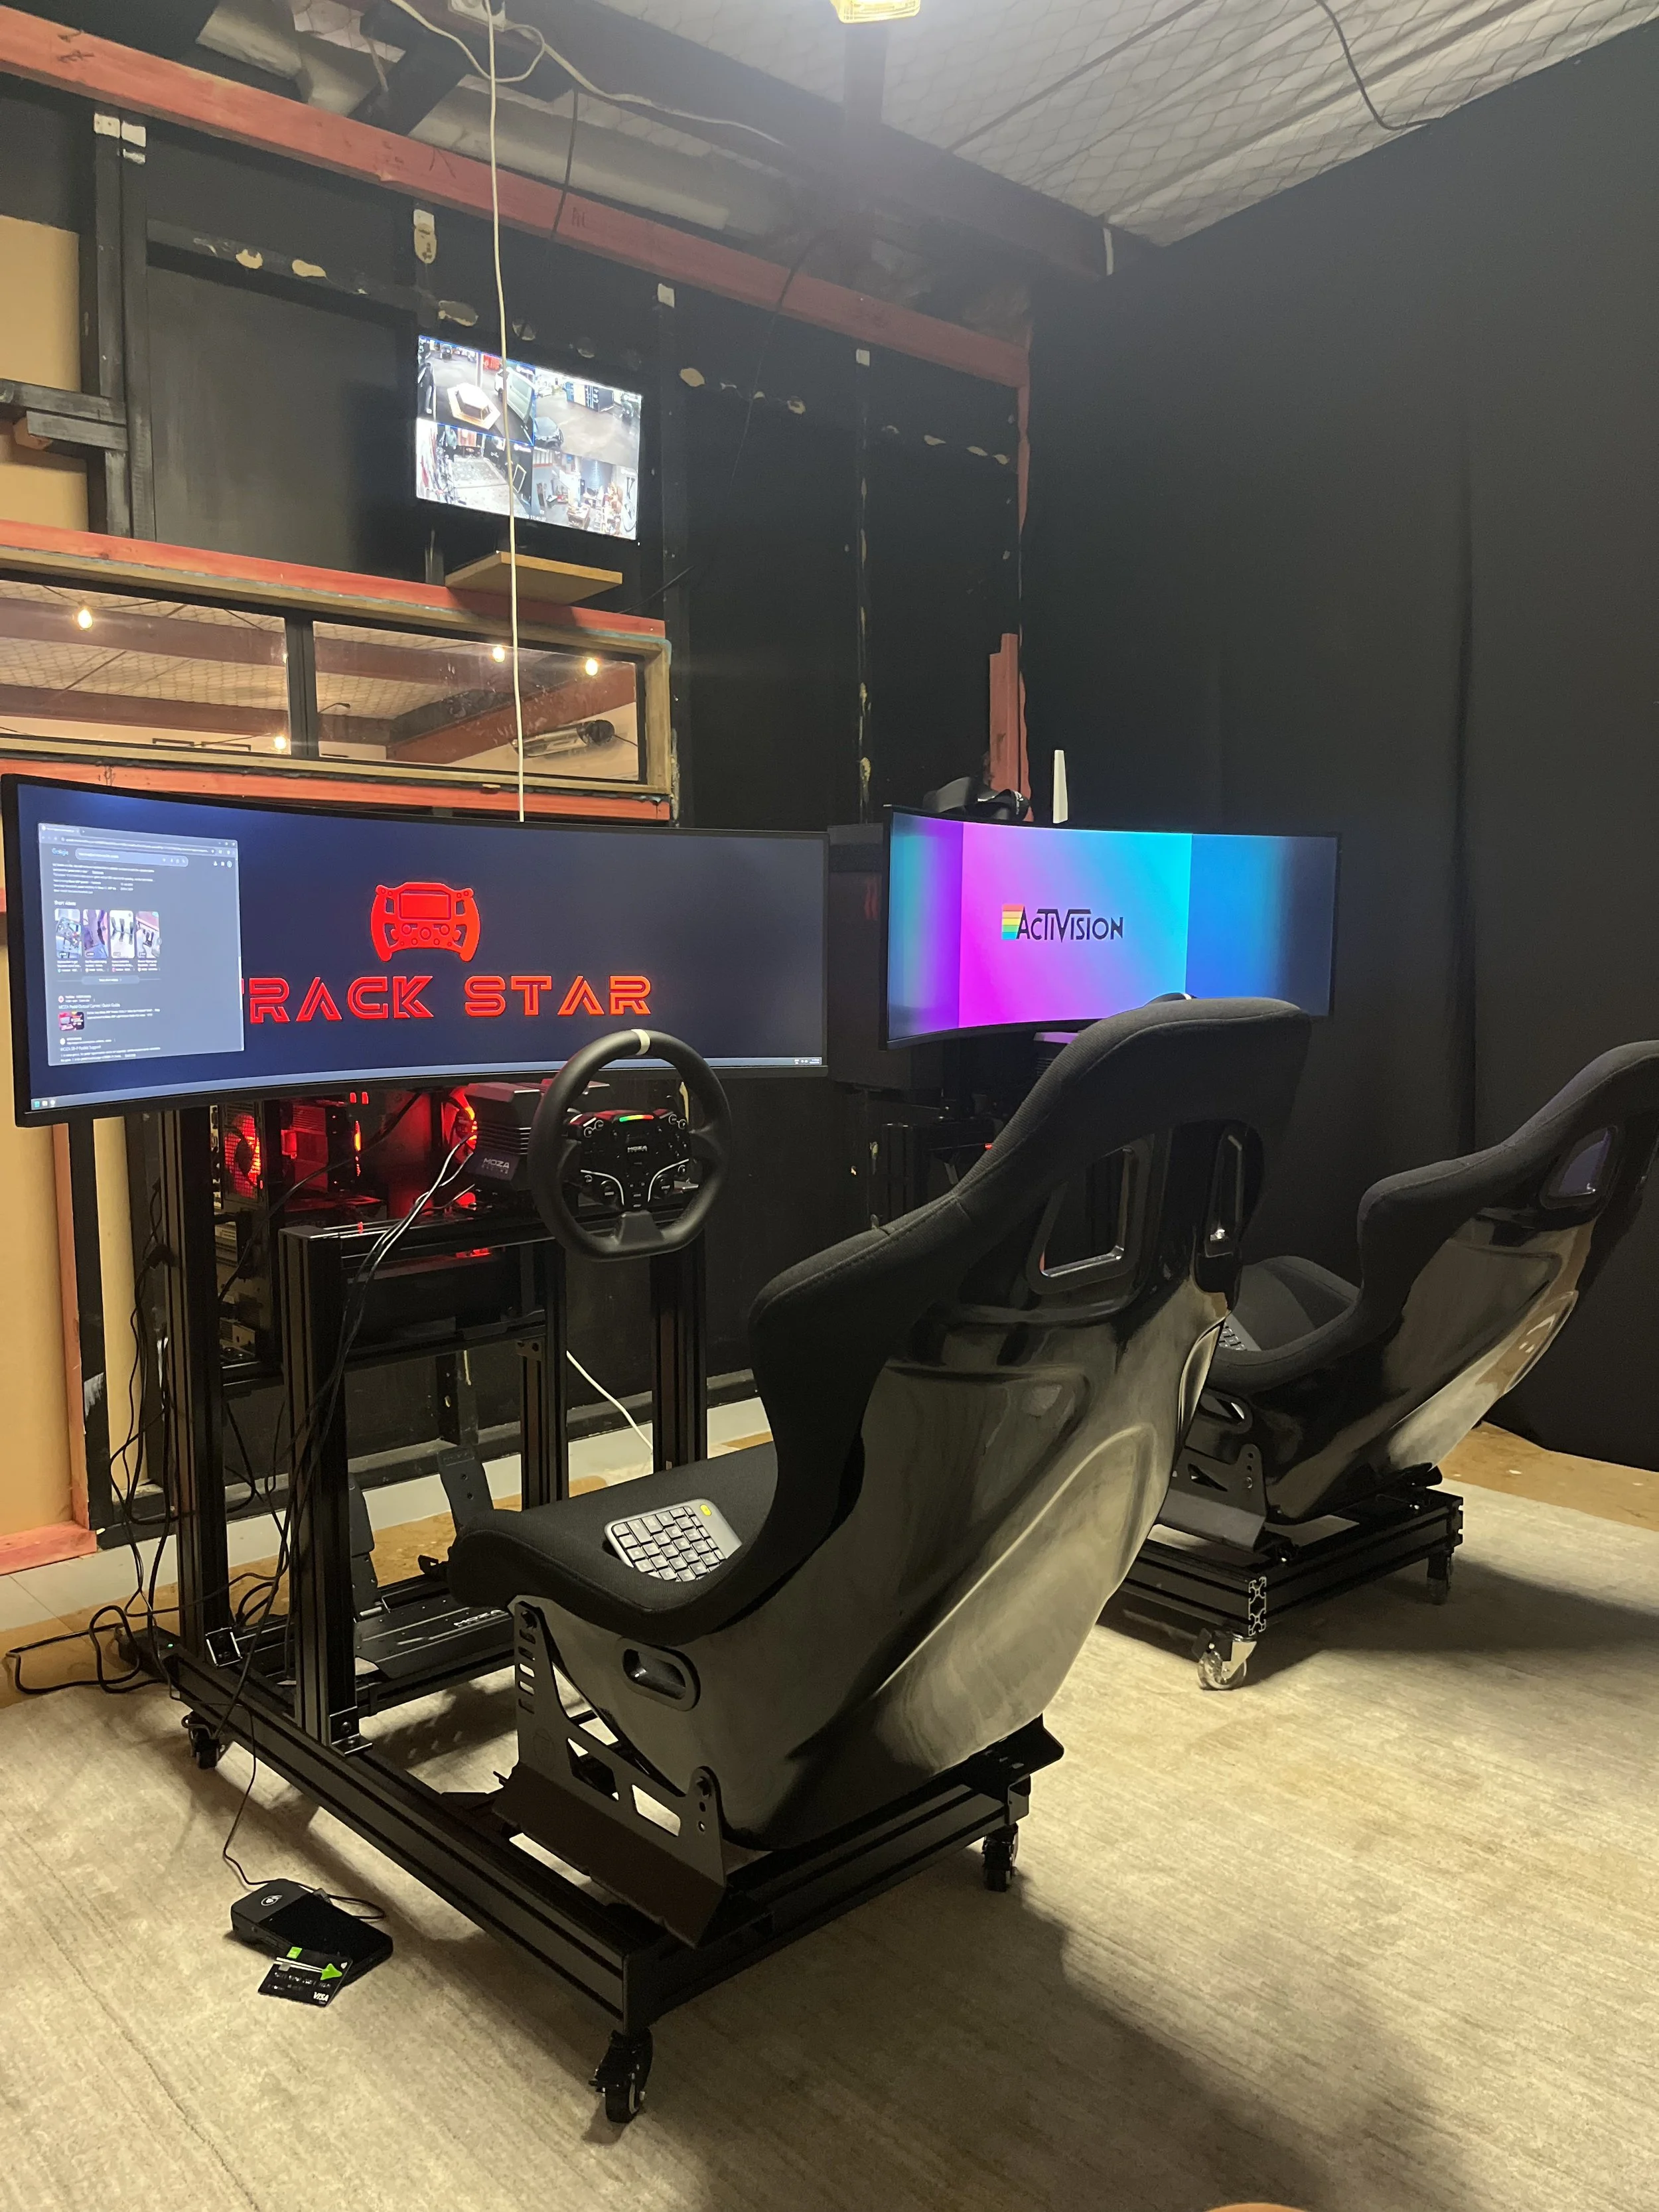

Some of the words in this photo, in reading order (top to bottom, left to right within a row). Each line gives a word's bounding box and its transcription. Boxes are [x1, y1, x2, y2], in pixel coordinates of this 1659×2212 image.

[242, 976, 434, 1024] RACK
[465, 976, 651, 1017] STAR
[483, 1157, 510, 1169] MOZA
[313, 1992, 329, 2002] VISA
